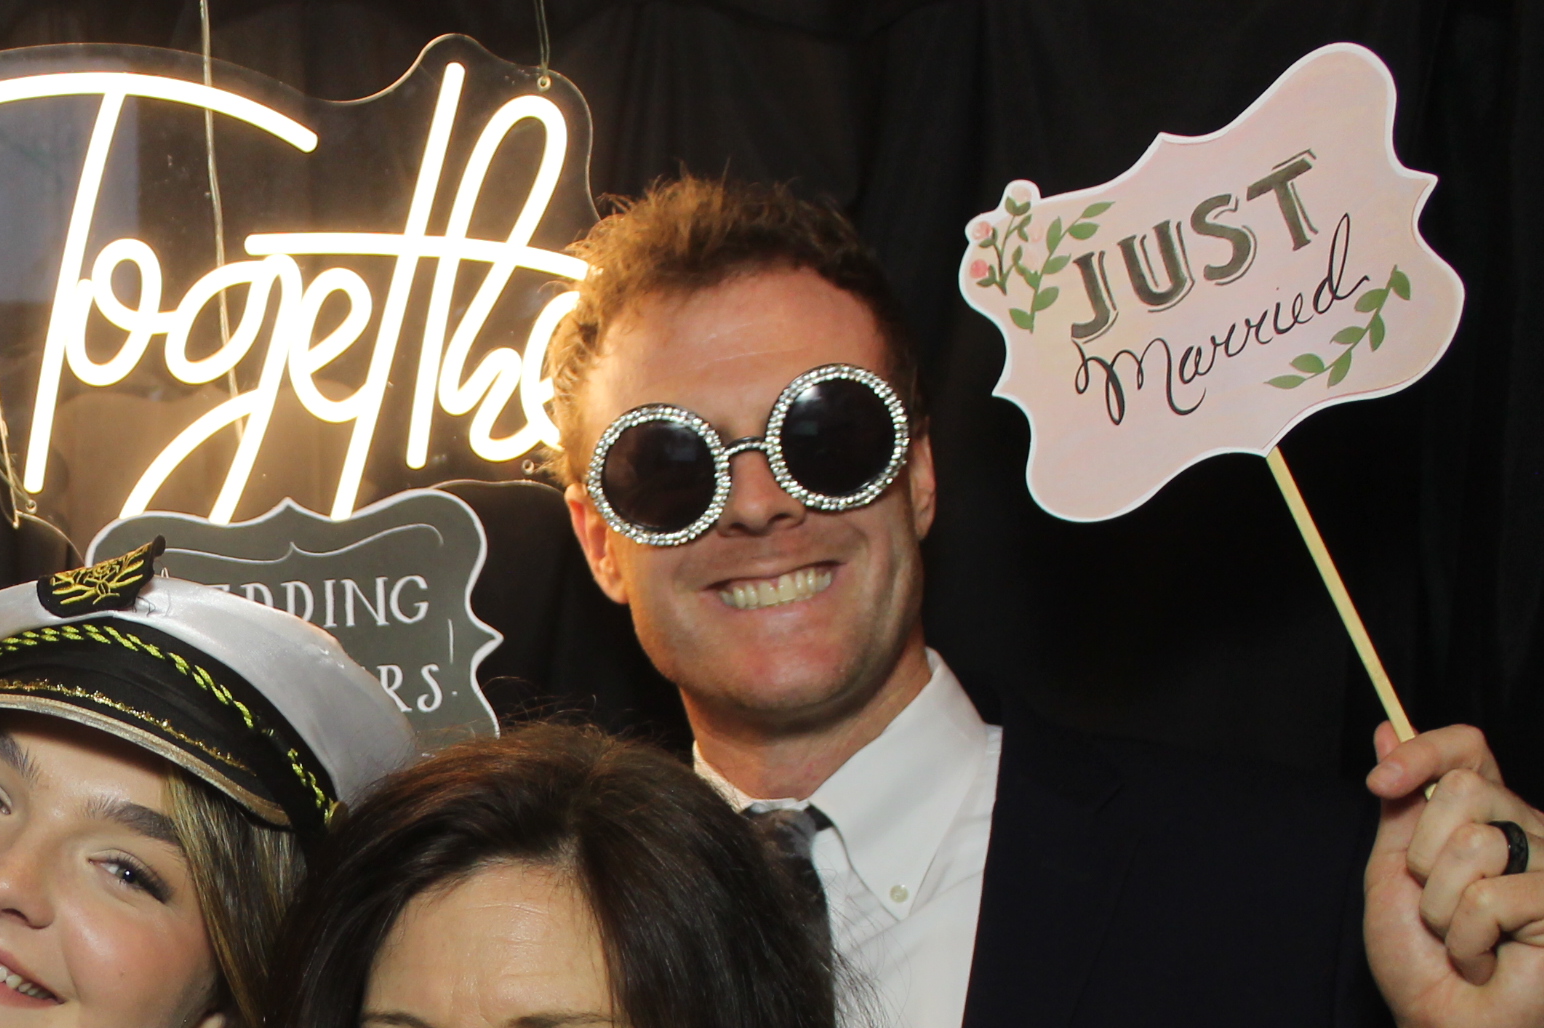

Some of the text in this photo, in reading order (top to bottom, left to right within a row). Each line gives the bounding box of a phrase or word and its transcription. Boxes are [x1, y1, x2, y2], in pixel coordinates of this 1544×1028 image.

[1070, 148, 1319, 344] JUST
[1070, 212, 1370, 426] Married
[160, 566, 429, 628] DING
